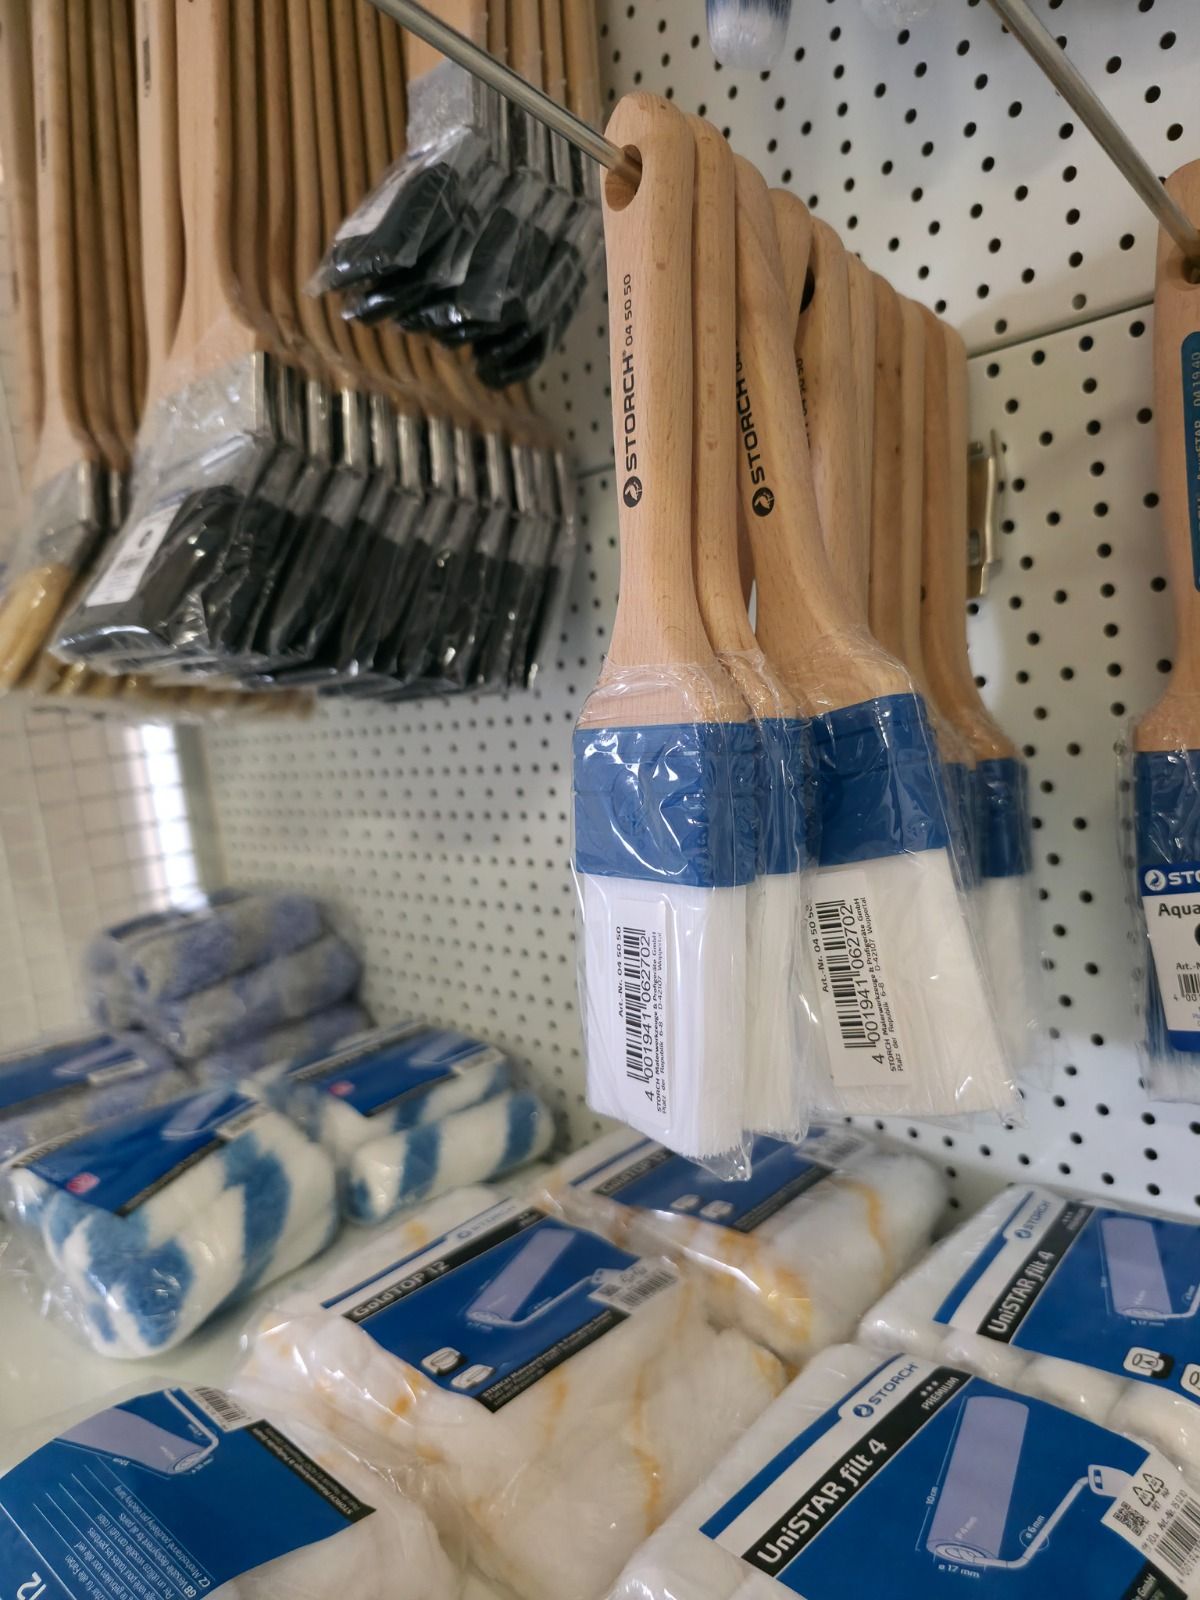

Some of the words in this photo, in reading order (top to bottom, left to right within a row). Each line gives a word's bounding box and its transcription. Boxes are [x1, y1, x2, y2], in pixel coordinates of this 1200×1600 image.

[623, 274, 632, 296] 50
[624, 299, 633, 321] 50
[625, 325, 634, 347] 04
[623, 354, 637, 473] STORCH
[736, 378, 766, 486] STORCH
[853, 898, 864, 922] GmbH
[860, 897, 873, 934] Wuppertal
[615, 926, 622, 941] 50
[809, 921, 818, 935] 50
[839, 904, 865, 970] 062702
[616, 943, 622, 958] 50
[812, 938, 821, 953] 04
[868, 938, 881, 972] D-42107
[617, 961, 623, 976] 04
[640, 935, 652, 1003] 062702
[855, 979, 881, 1042] 001941
[882, 1001, 895, 1033] Republik
[641, 1012, 654, 1079] 001941
[872, 1053, 885, 1065] 4
[884, 1038, 897, 1072] STORCH
[644, 1090, 655, 1102] 4
[352, 1272, 426, 1318] GoldTOP
[426, 1260, 450, 1275] 12
[987, 1274, 1037, 1334] UniSTAR
[1026, 1258, 1052, 1282] filt
[1042, 1250, 1055, 1260] 4
[868, 1362, 919, 1405] STORCH
[921, 1376, 960, 1411] PREMIUM
[756, 1481, 847, 1564] UniSTAR
[839, 1453, 875, 1488] filt
[867, 1437, 888, 1454] 4
[198, 1575, 211, 1588] CZ
[960, 1568, 980, 1579] mm
[183, 1584, 197, 1598] GB
